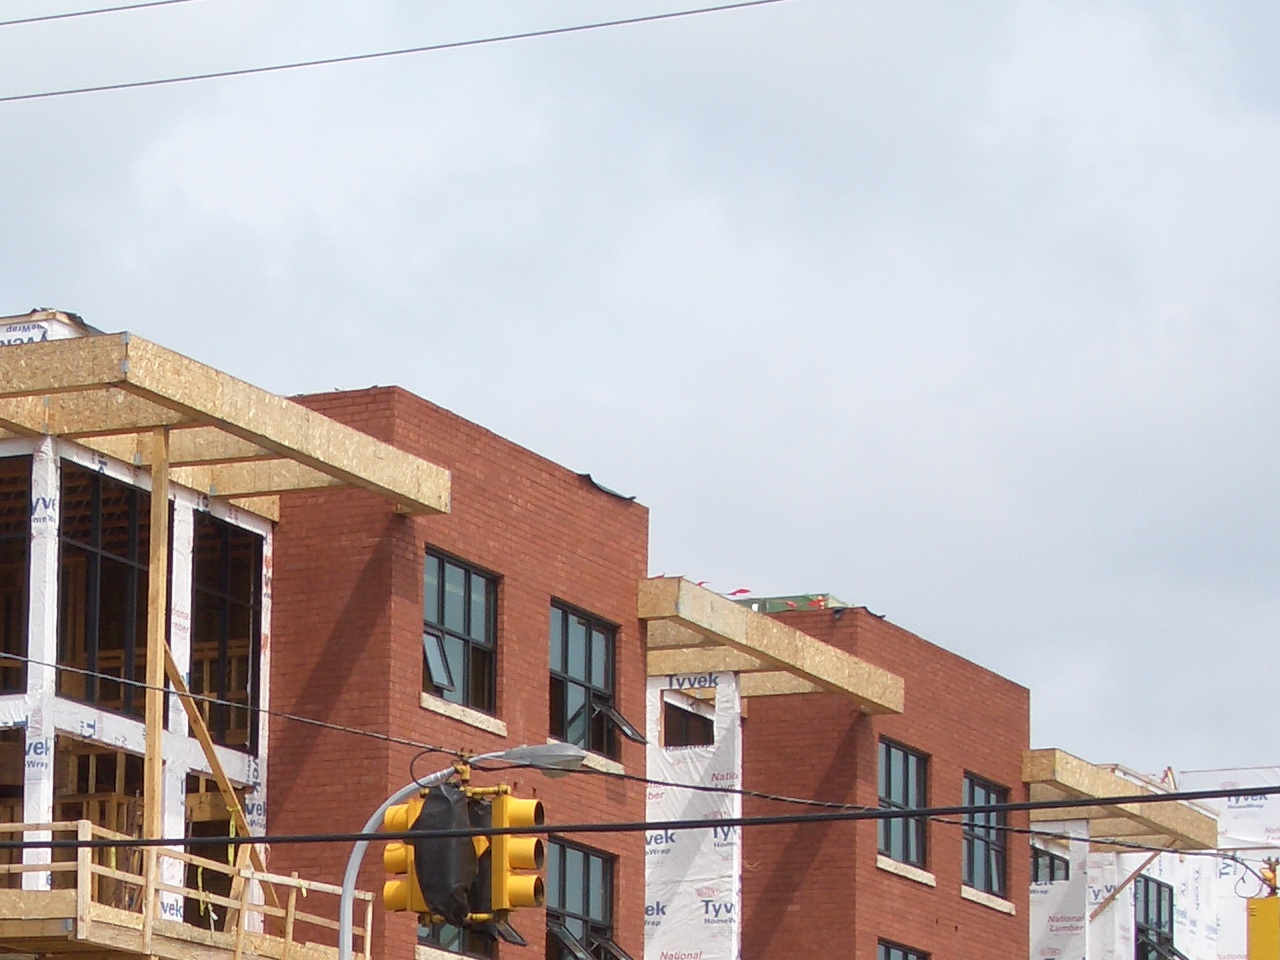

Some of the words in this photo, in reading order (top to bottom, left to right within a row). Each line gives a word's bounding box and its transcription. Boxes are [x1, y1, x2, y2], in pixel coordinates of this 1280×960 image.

[645, 828, 676, 846] vek
[701, 900, 737, 918] Tyv
[660, 951, 703, 960] National
